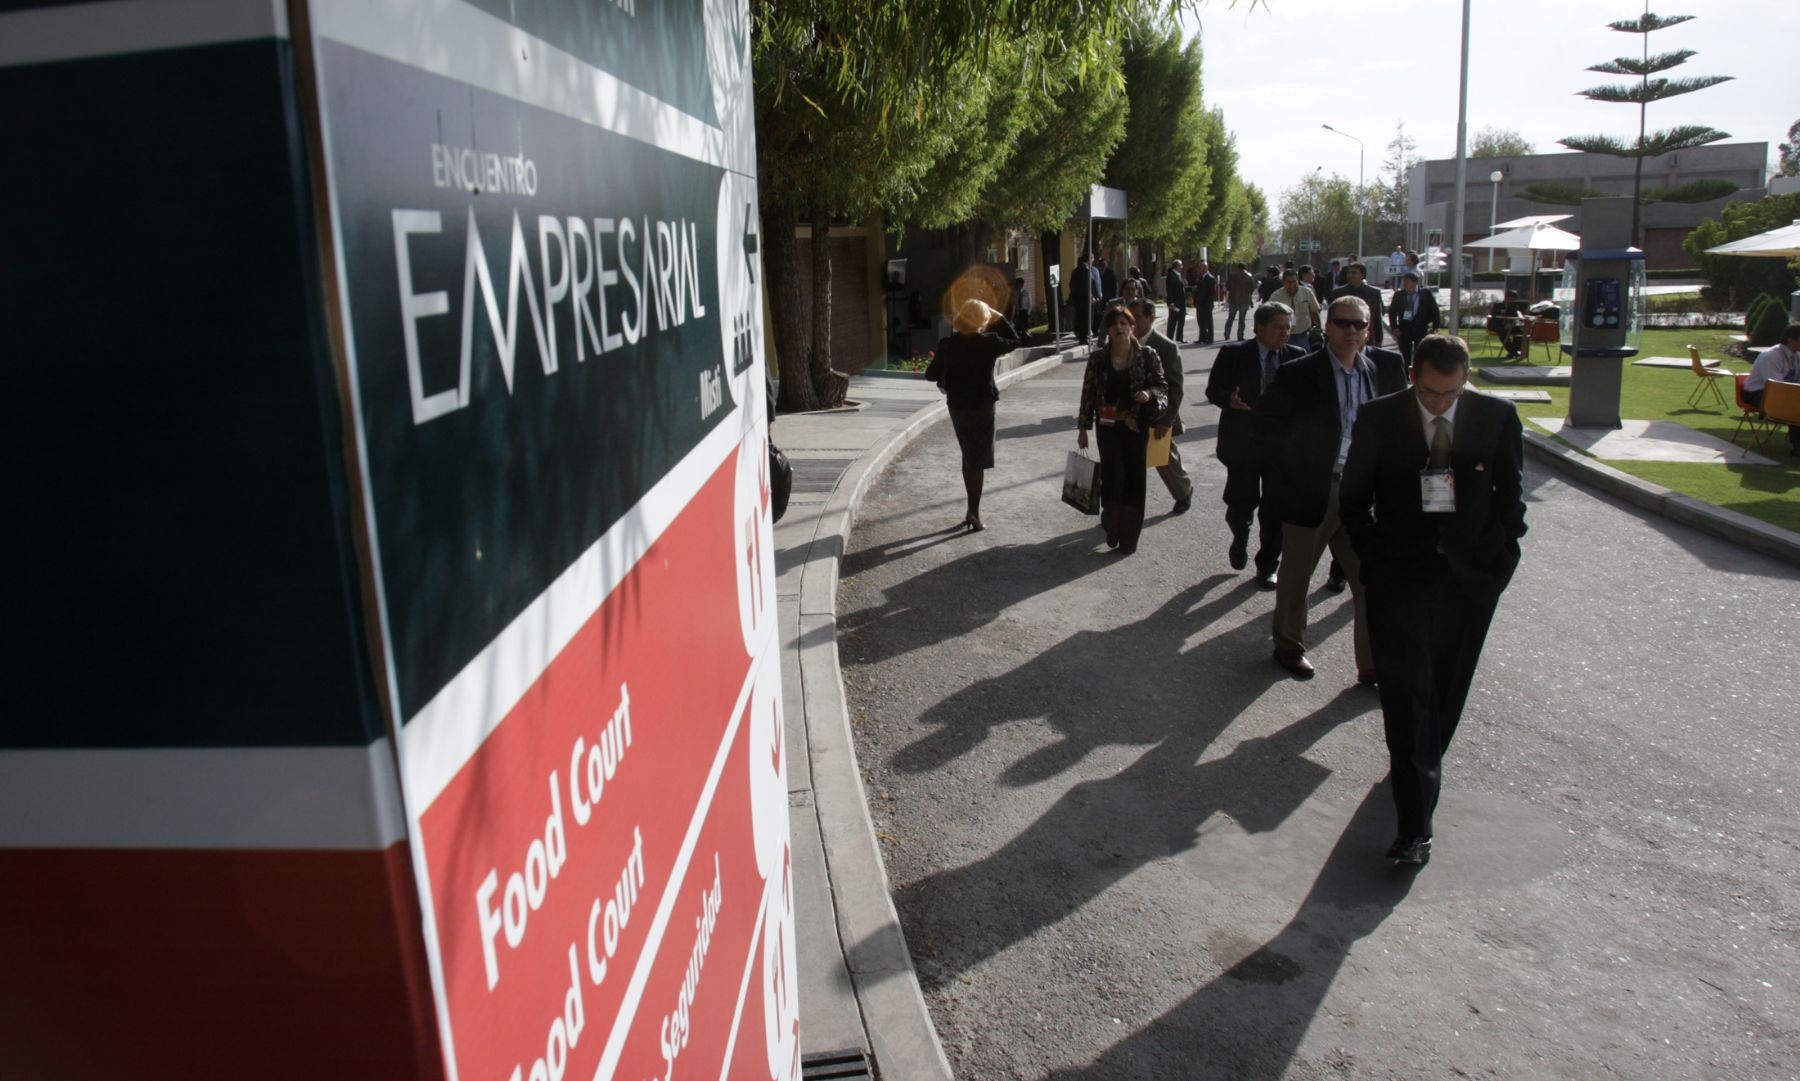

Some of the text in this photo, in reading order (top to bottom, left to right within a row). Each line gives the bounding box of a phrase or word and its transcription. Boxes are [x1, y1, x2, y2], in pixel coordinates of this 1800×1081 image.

[430, 143, 538, 197] ENCUENTRO
[391, 205, 706, 426] EMPRESARIAL
[475, 681, 633, 992] Food Court
[508, 825, 645, 1081] od Court
[660, 851, 722, 1081] Seguridad
